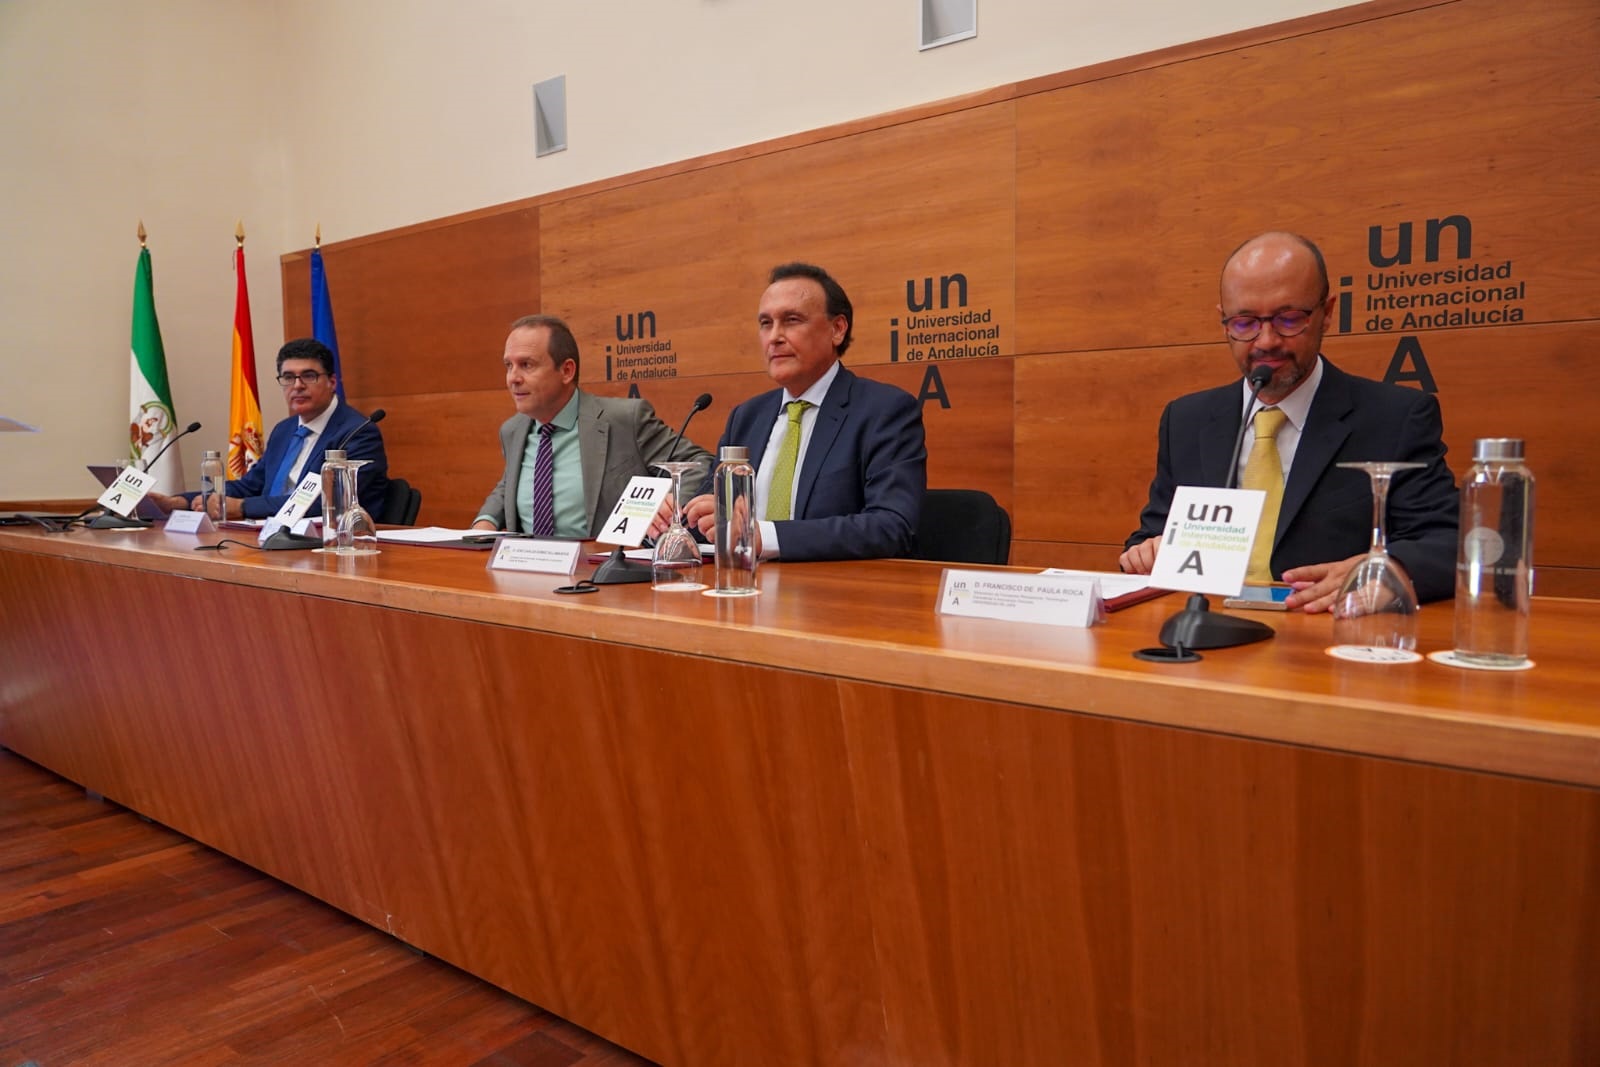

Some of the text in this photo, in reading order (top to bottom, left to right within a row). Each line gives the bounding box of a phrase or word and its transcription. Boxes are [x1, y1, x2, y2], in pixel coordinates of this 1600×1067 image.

[1368, 214, 1472, 268] un
[1367, 260, 1512, 291] Universidad
[906, 272, 968, 313] un
[1339, 275, 1353, 334] i
[1366, 281, 1526, 312] Internacional
[615, 310, 656, 342] un
[906, 308, 992, 330] Universidad
[1365, 304, 1525, 332] de Andalucía
[890, 317, 899, 362] i
[906, 324, 1000, 346] Internacional
[616, 340, 672, 356] Universidad
[906, 341, 1000, 361] de Andalucía
[606, 345, 612, 381] i
[616, 352, 677, 369] Internacional
[1382, 335, 1439, 393] A
[616, 369, 628, 381] de
[917, 364, 952, 409] A
[125, 474, 143, 488] un
[630, 486, 655, 500] un
[110, 493, 122, 505] A
[1187, 503, 1233, 523] un
[612, 517, 629, 534] A
[1166, 521, 1178, 545] i
[1183, 521, 1246, 535] Universidad
[1177, 550, 1204, 576] A
